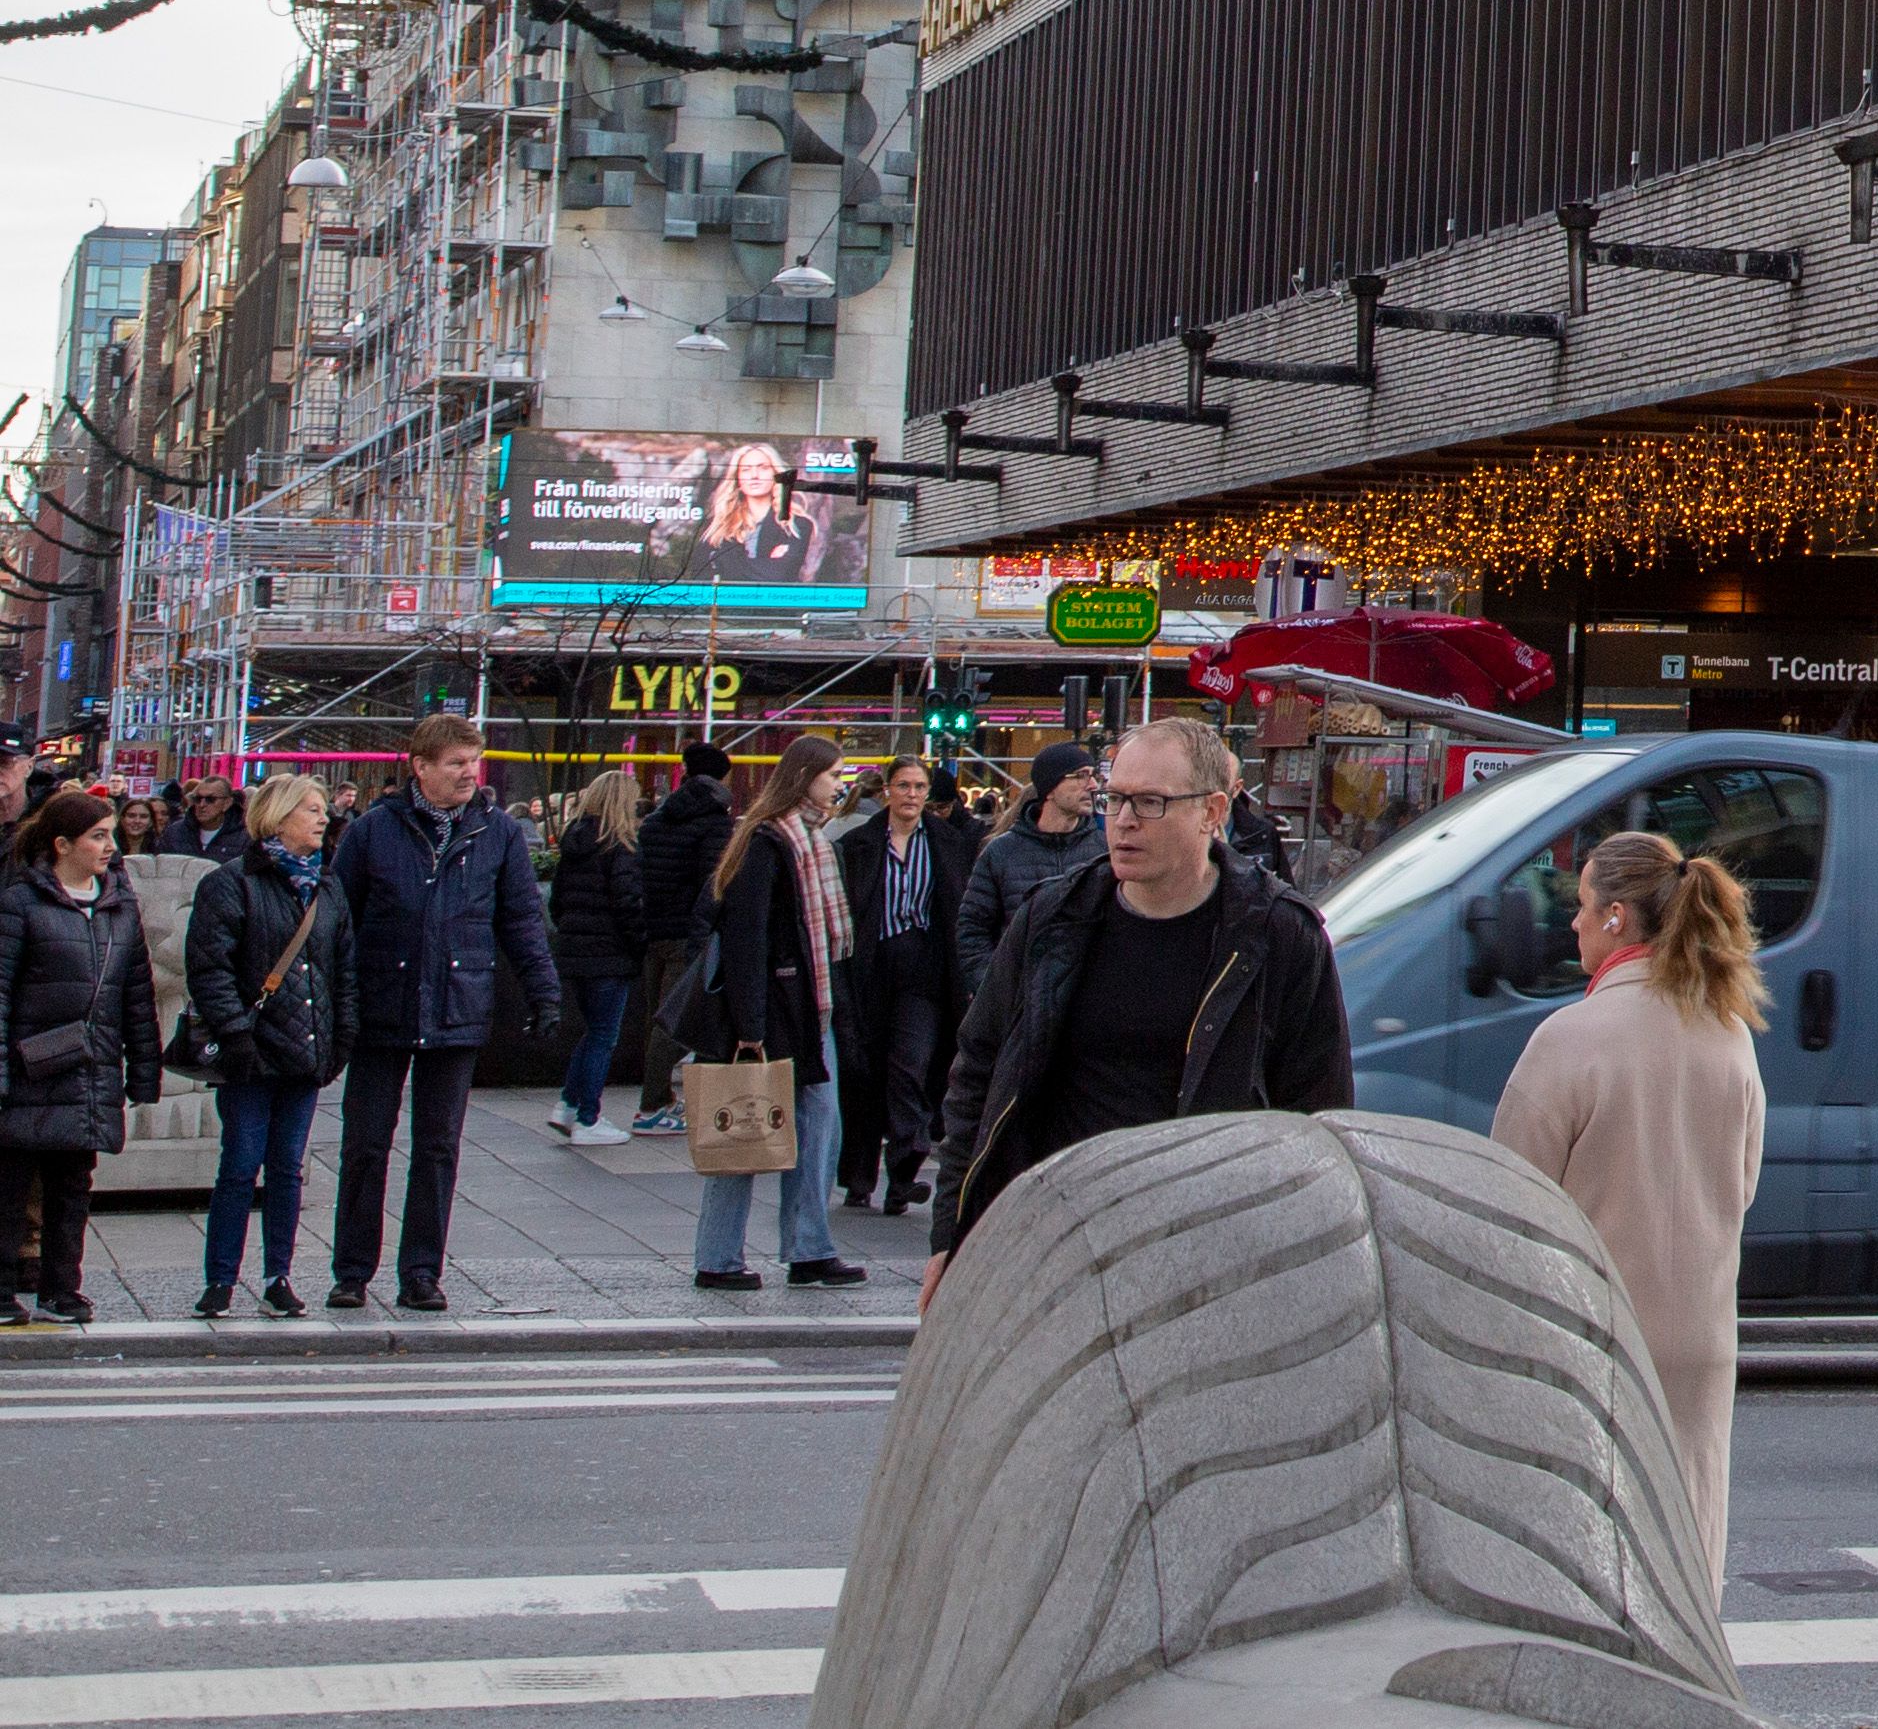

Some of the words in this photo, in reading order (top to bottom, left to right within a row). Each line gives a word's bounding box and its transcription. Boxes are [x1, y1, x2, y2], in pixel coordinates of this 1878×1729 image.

[805, 453, 855, 468] SVEA
[534, 479, 579, 498] Från
[582, 480, 694, 503] finansiering
[532, 500, 561, 519] till
[564, 501, 703, 523] förverkligande
[1071, 602, 1142, 615] SYSTEM
[1065, 617, 1147, 629] BOLAGET
[1691, 655, 1750, 667] Tunnelbana
[1691, 668, 1723, 680] Metro
[609, 664, 742, 711] LYKO
